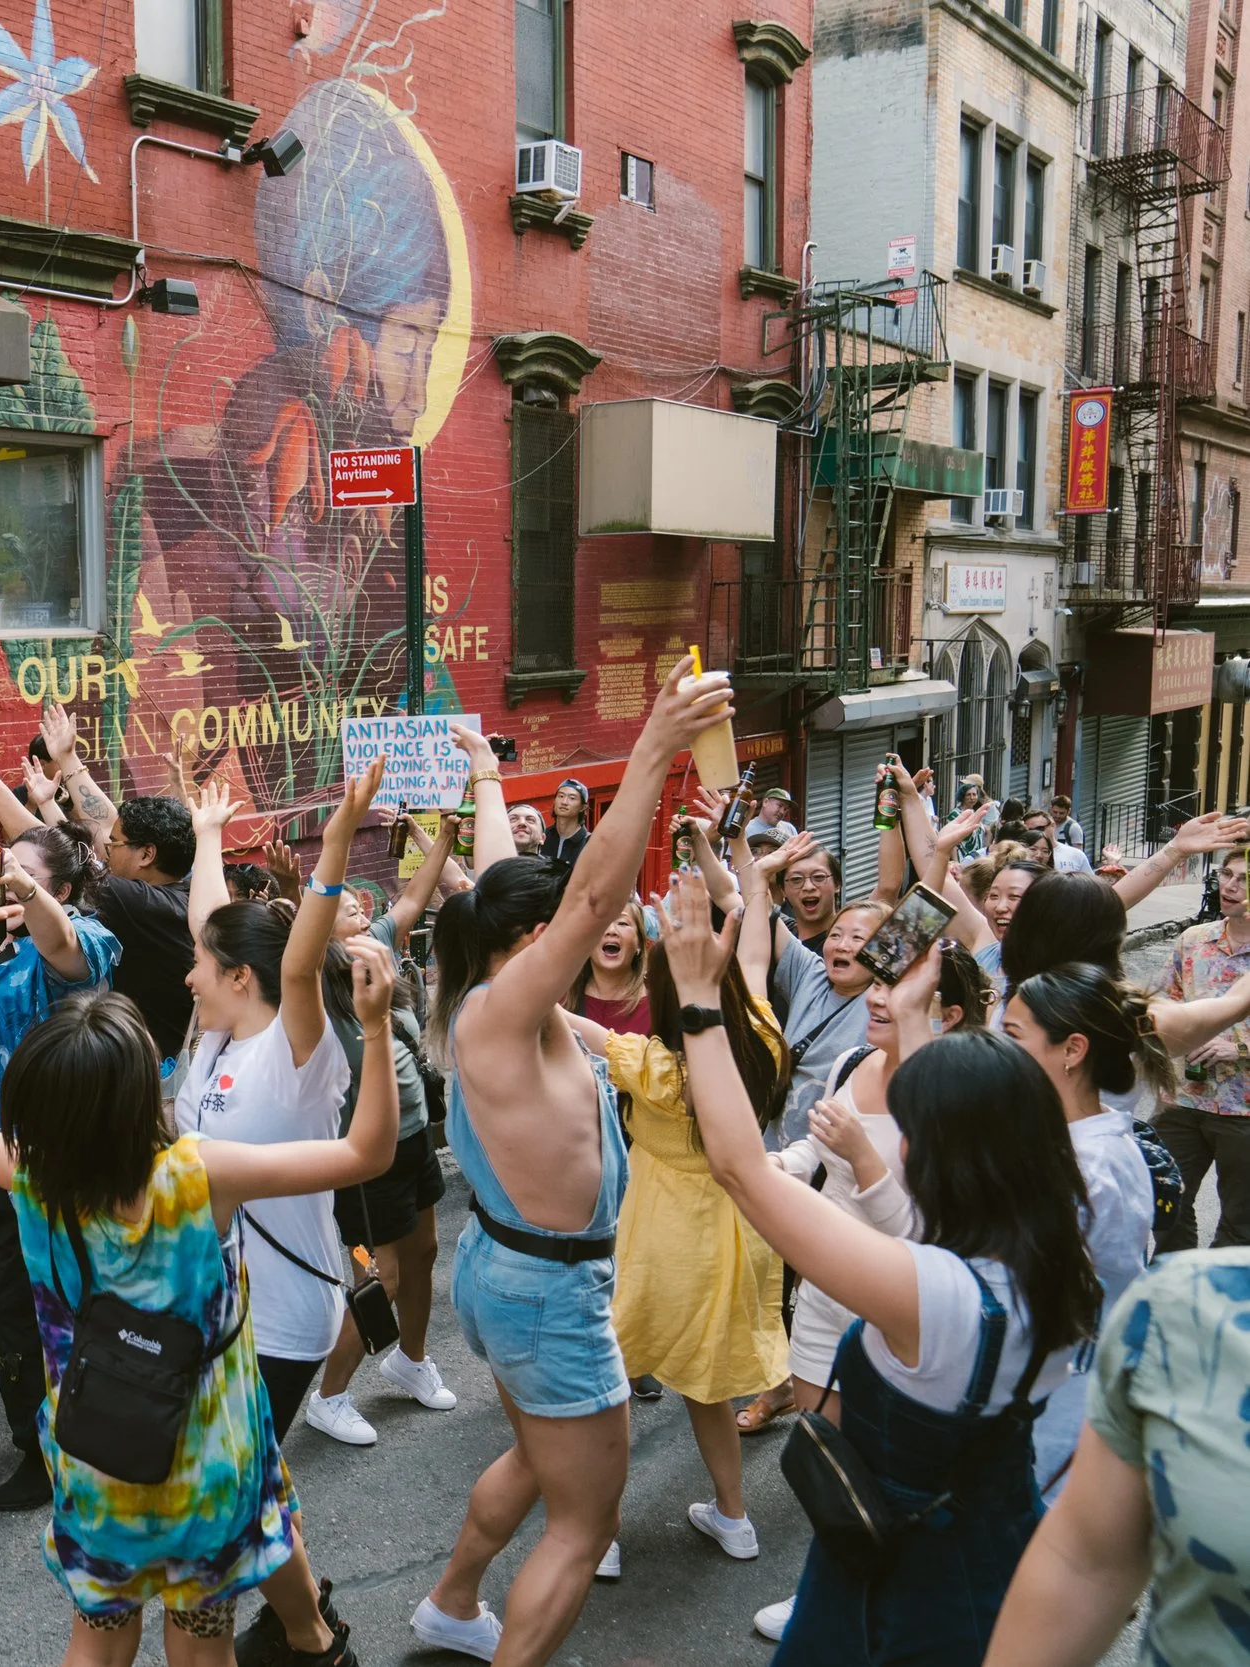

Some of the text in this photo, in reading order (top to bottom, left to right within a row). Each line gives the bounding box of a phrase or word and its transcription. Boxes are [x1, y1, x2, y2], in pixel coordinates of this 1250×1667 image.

[334, 454, 401, 468] NO STANDING
[335, 468, 378, 482] Anytime
[425, 574, 449, 614] IS
[423, 624, 489, 663] SAFE
[17, 654, 108, 705] OUR
[75, 696, 388, 762] SIAN COMMUNITY
[346, 719, 448, 742] ANTI-ASIAN
[347, 741, 451, 759] VIOLENCE IS
[429, 776, 438, 790] A
[128, 1330, 162, 1351] Columbia
